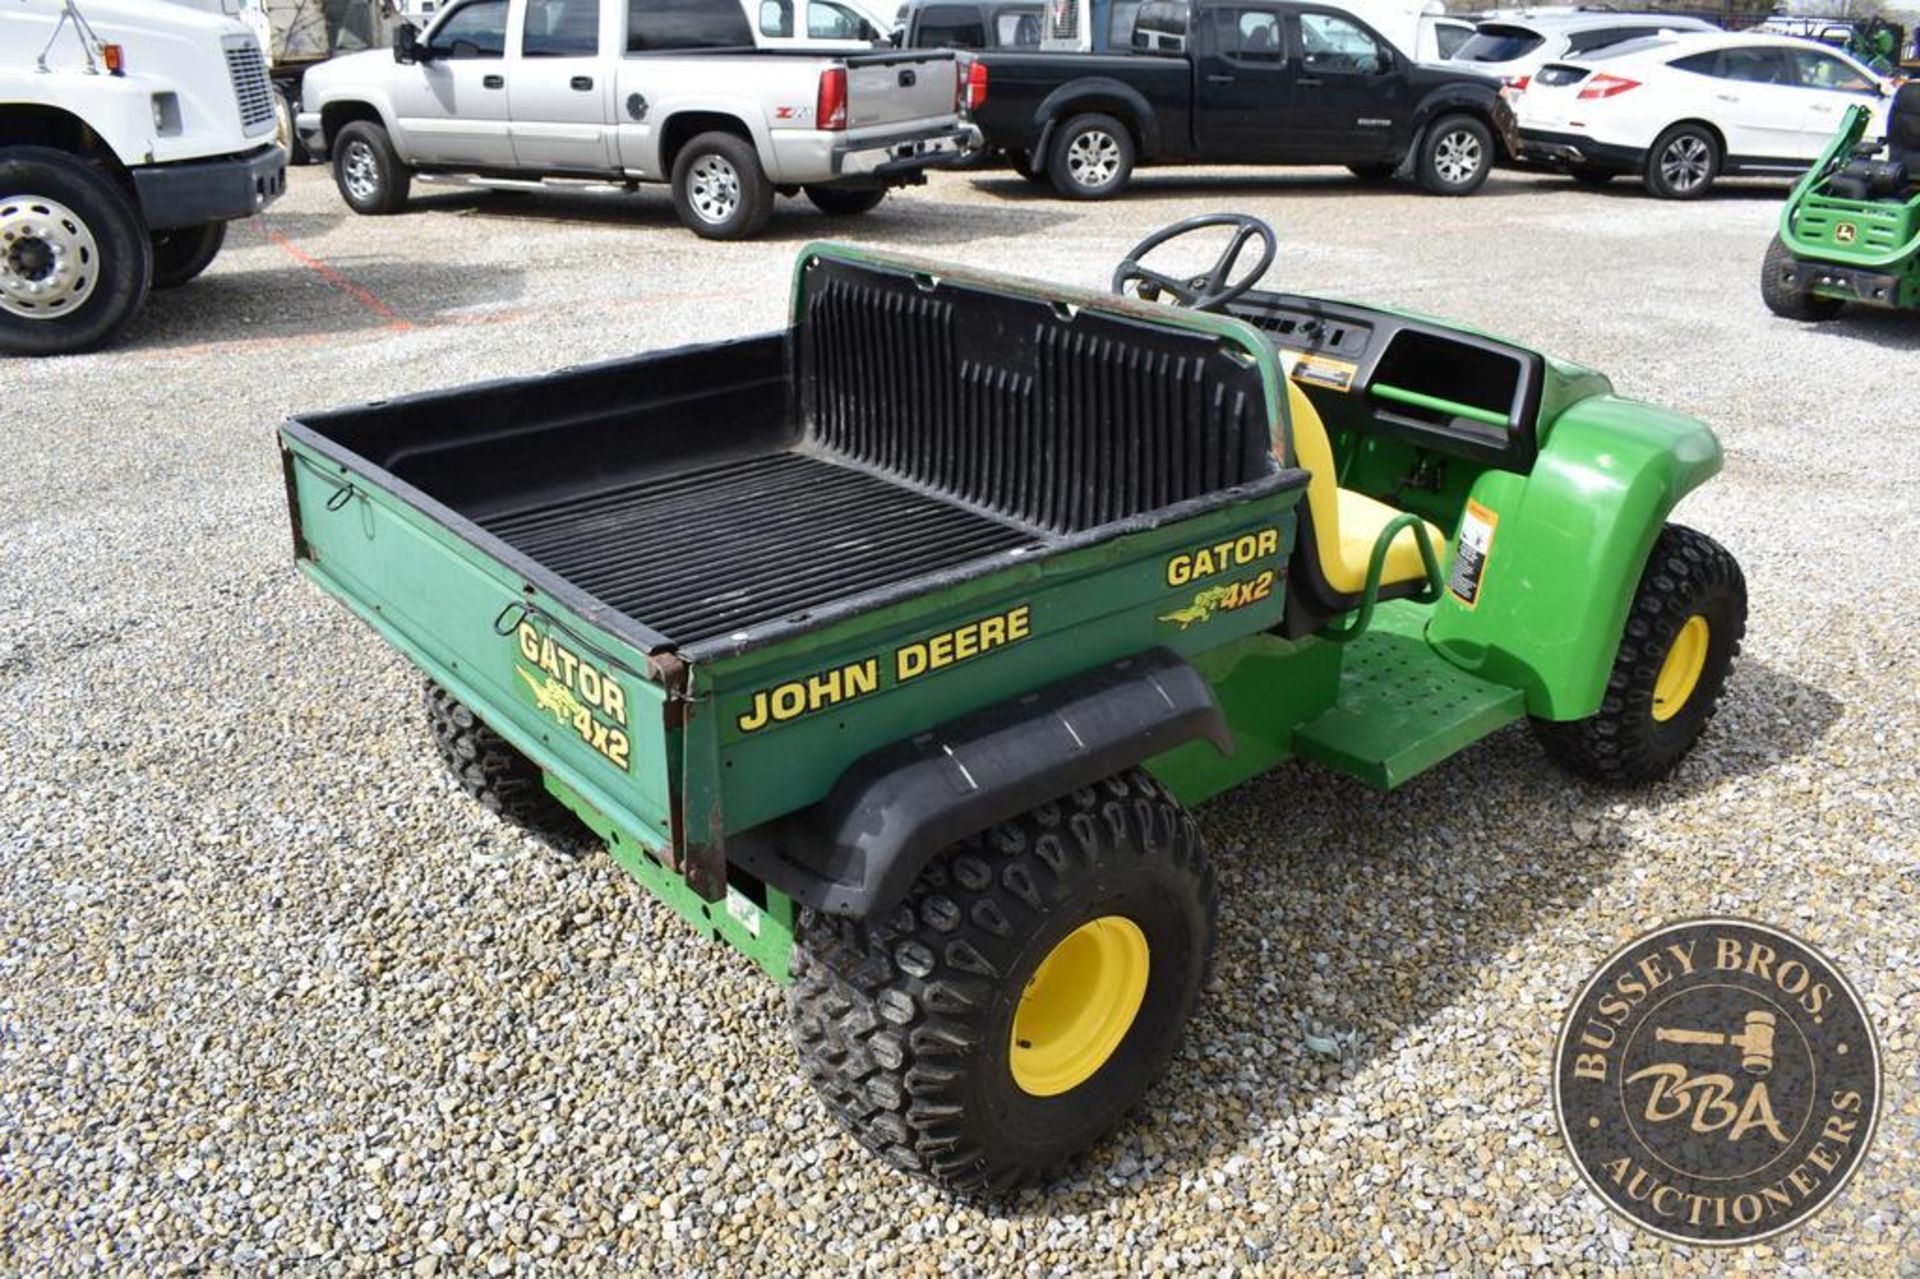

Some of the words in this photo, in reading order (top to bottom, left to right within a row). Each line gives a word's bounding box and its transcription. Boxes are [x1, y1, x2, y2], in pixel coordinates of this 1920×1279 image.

[1167, 528, 1279, 587] GATOR
[518, 621, 628, 727] GATOR
[739, 658, 878, 732] JOHN
[897, 605, 1030, 681] DEERE
